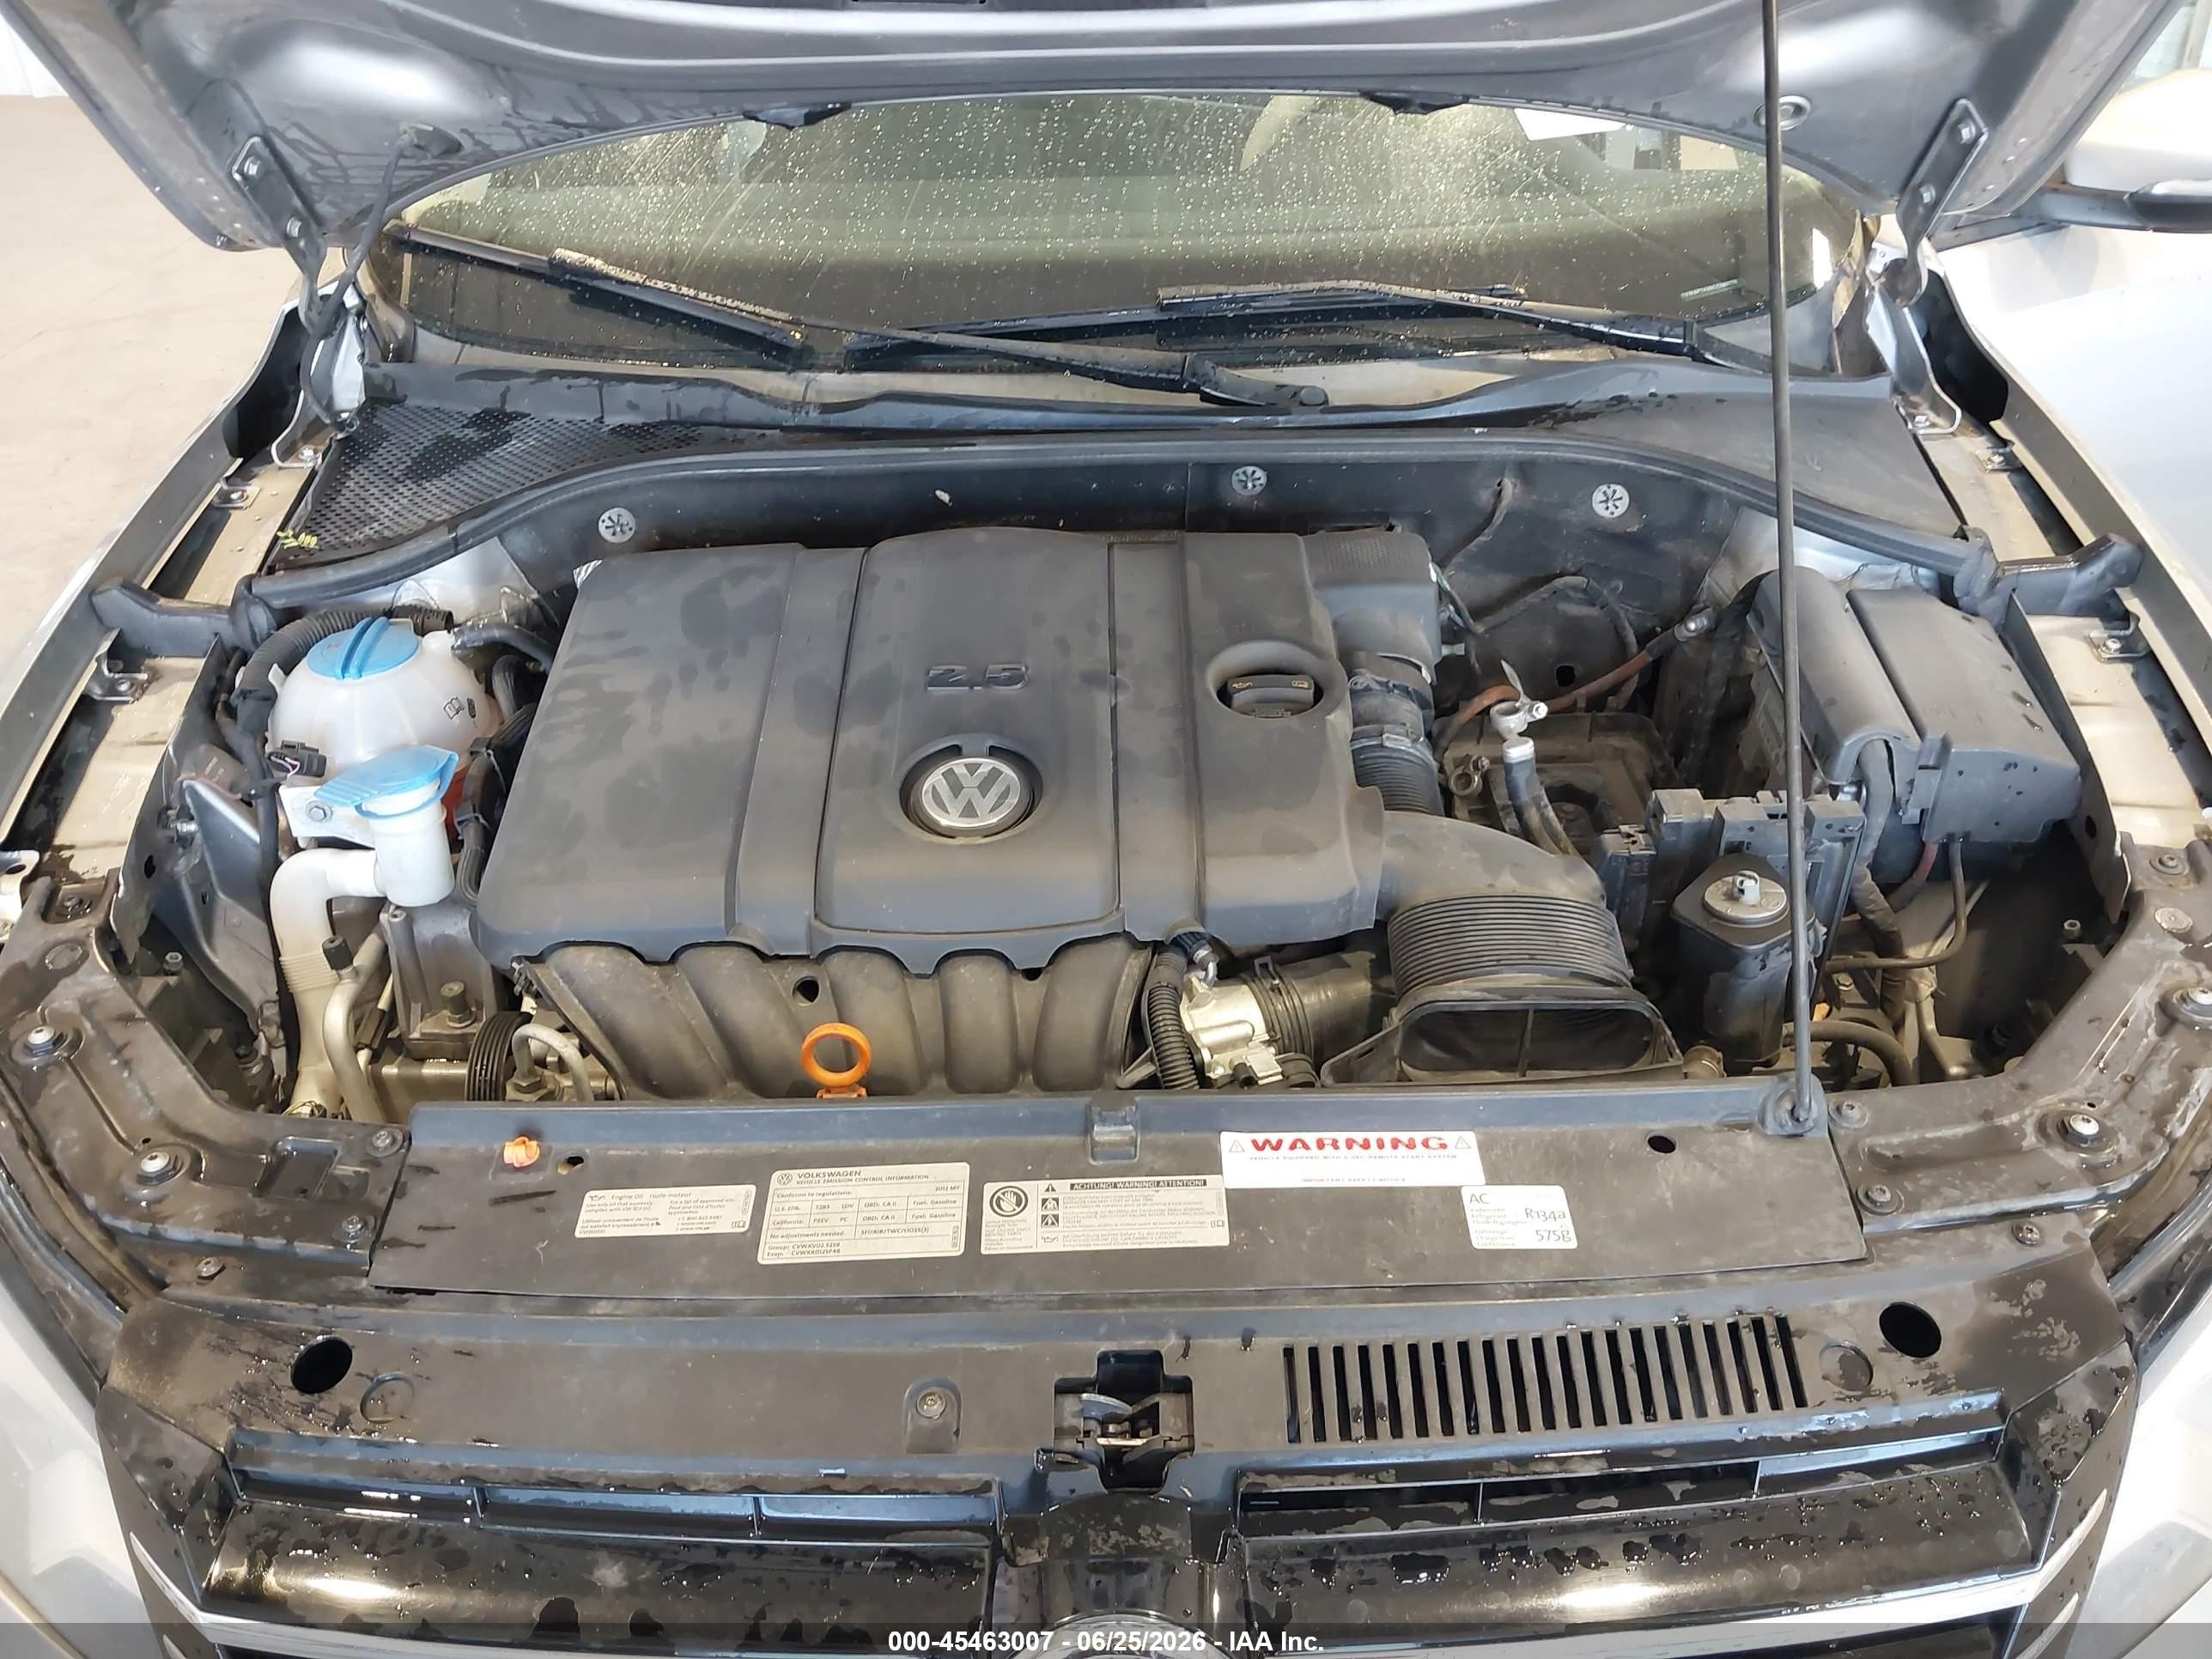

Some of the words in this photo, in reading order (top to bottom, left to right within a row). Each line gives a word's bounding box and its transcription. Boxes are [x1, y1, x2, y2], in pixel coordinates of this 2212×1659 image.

[927, 663, 1030, 692] 2.5
[1251, 1137, 1448, 1152] WARNING
[798, 1170, 862, 1179] VOLKSWAGEN
[1469, 1193, 1490, 1204] AC
[1524, 1207, 1566, 1222] R134a
